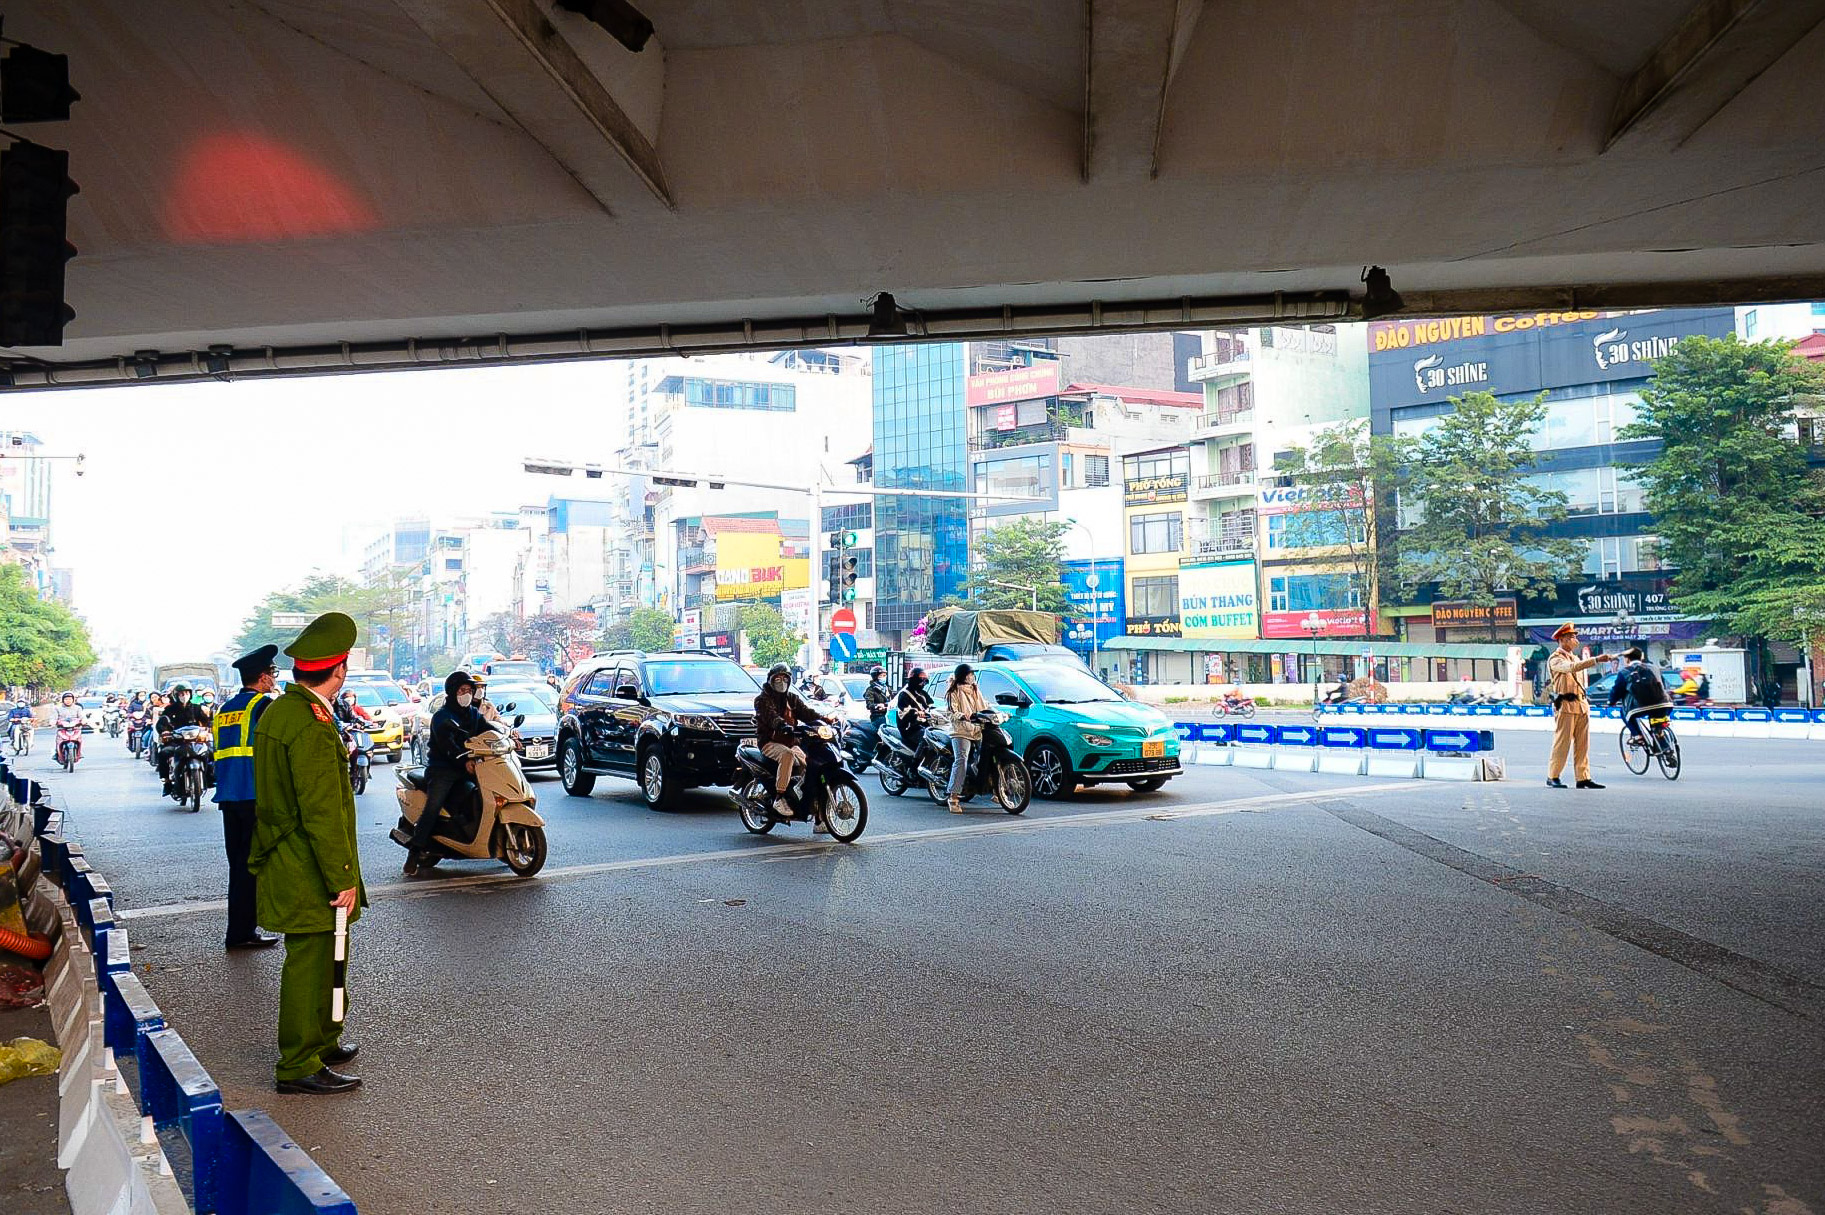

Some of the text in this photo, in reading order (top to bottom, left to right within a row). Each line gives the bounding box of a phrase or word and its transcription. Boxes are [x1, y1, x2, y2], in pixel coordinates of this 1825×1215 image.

[1375, 325, 1410, 351] ĐÀO
[1608, 344, 1628, 364] 30
[1427, 368, 1445, 388] 30
[1182, 594, 1253, 610] BÚN THANG
[1587, 595, 1602, 610] 30
[1645, 594, 1664, 603] 407
[1184, 613, 1208, 628] CƠM
[1211, 612, 1254, 627] BUFFET
[1435, 607, 1452, 619] ĐÀO
[1485, 606, 1513, 618] CFFEE
